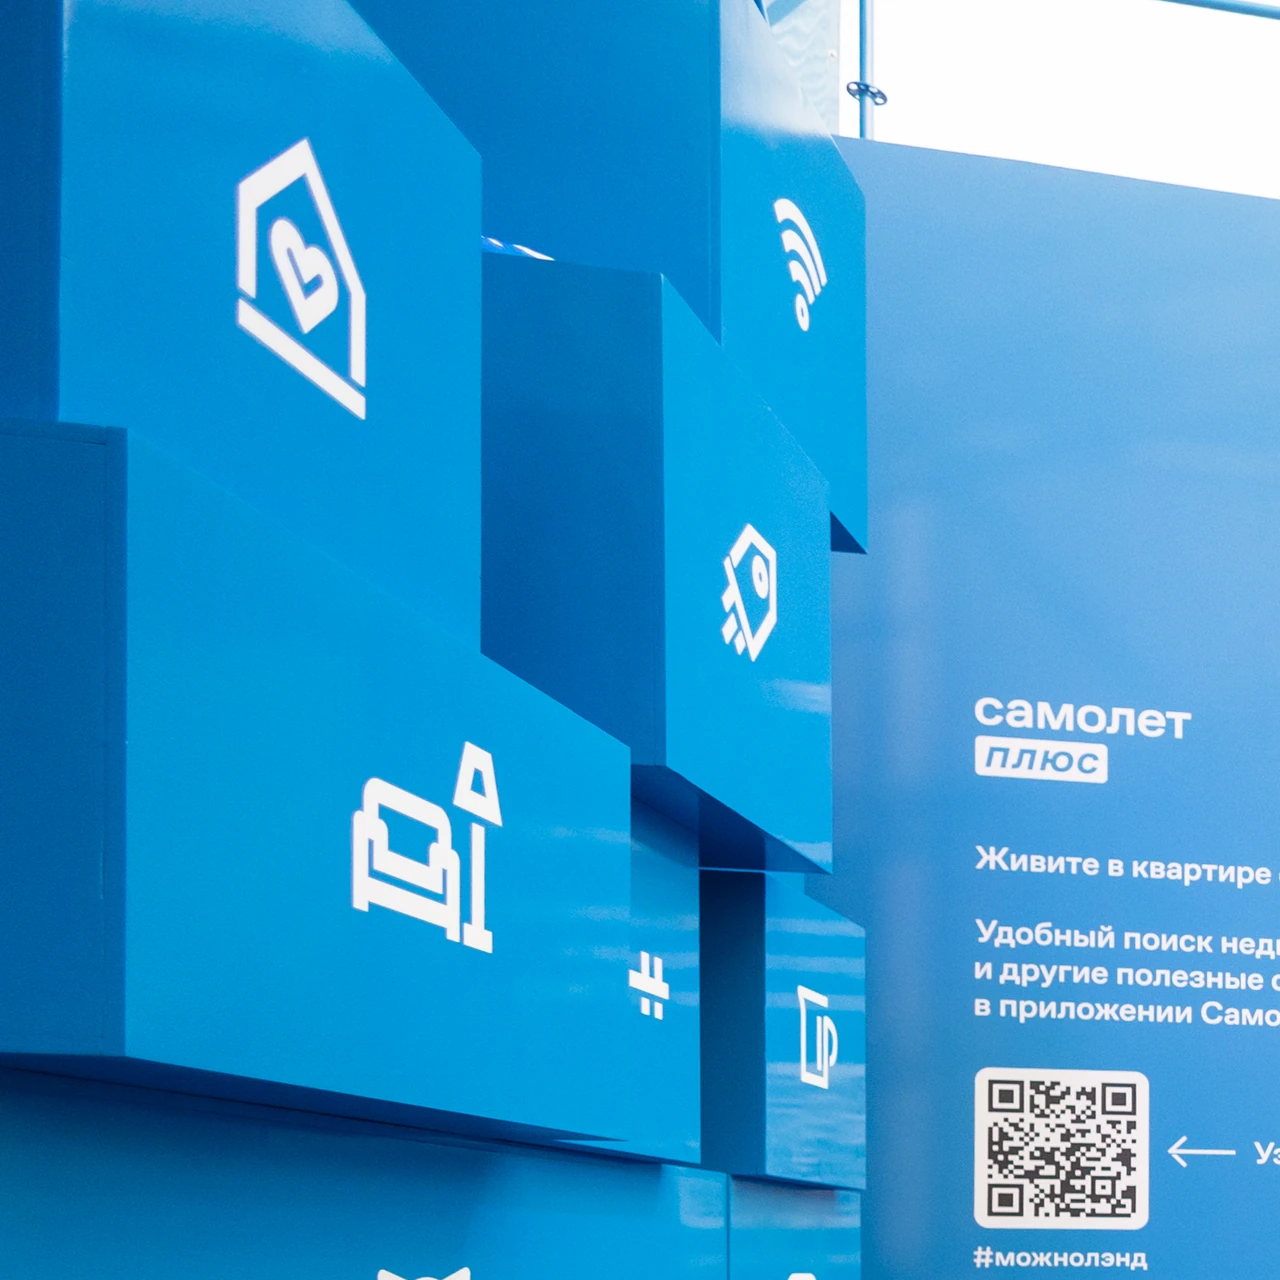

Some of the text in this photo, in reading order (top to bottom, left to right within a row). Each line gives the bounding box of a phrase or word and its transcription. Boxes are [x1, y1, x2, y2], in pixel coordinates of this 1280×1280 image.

[974, 697, 1193, 739] самолет
[975, 845, 1100, 876] Живите
[1107, 858, 1125, 877] в
[1132, 860, 1272, 890] квартире
[975, 918, 1115, 949] Удобный
[1123, 931, 1213, 953] поиск
[974, 961, 993, 980] и
[999, 962, 1109, 988] другие
[1116, 967, 1264, 992] полезные
[974, 998, 991, 1017] в
[999, 999, 1193, 1025] приложении
[973, 1246, 1149, 1271] #можнолэнд
